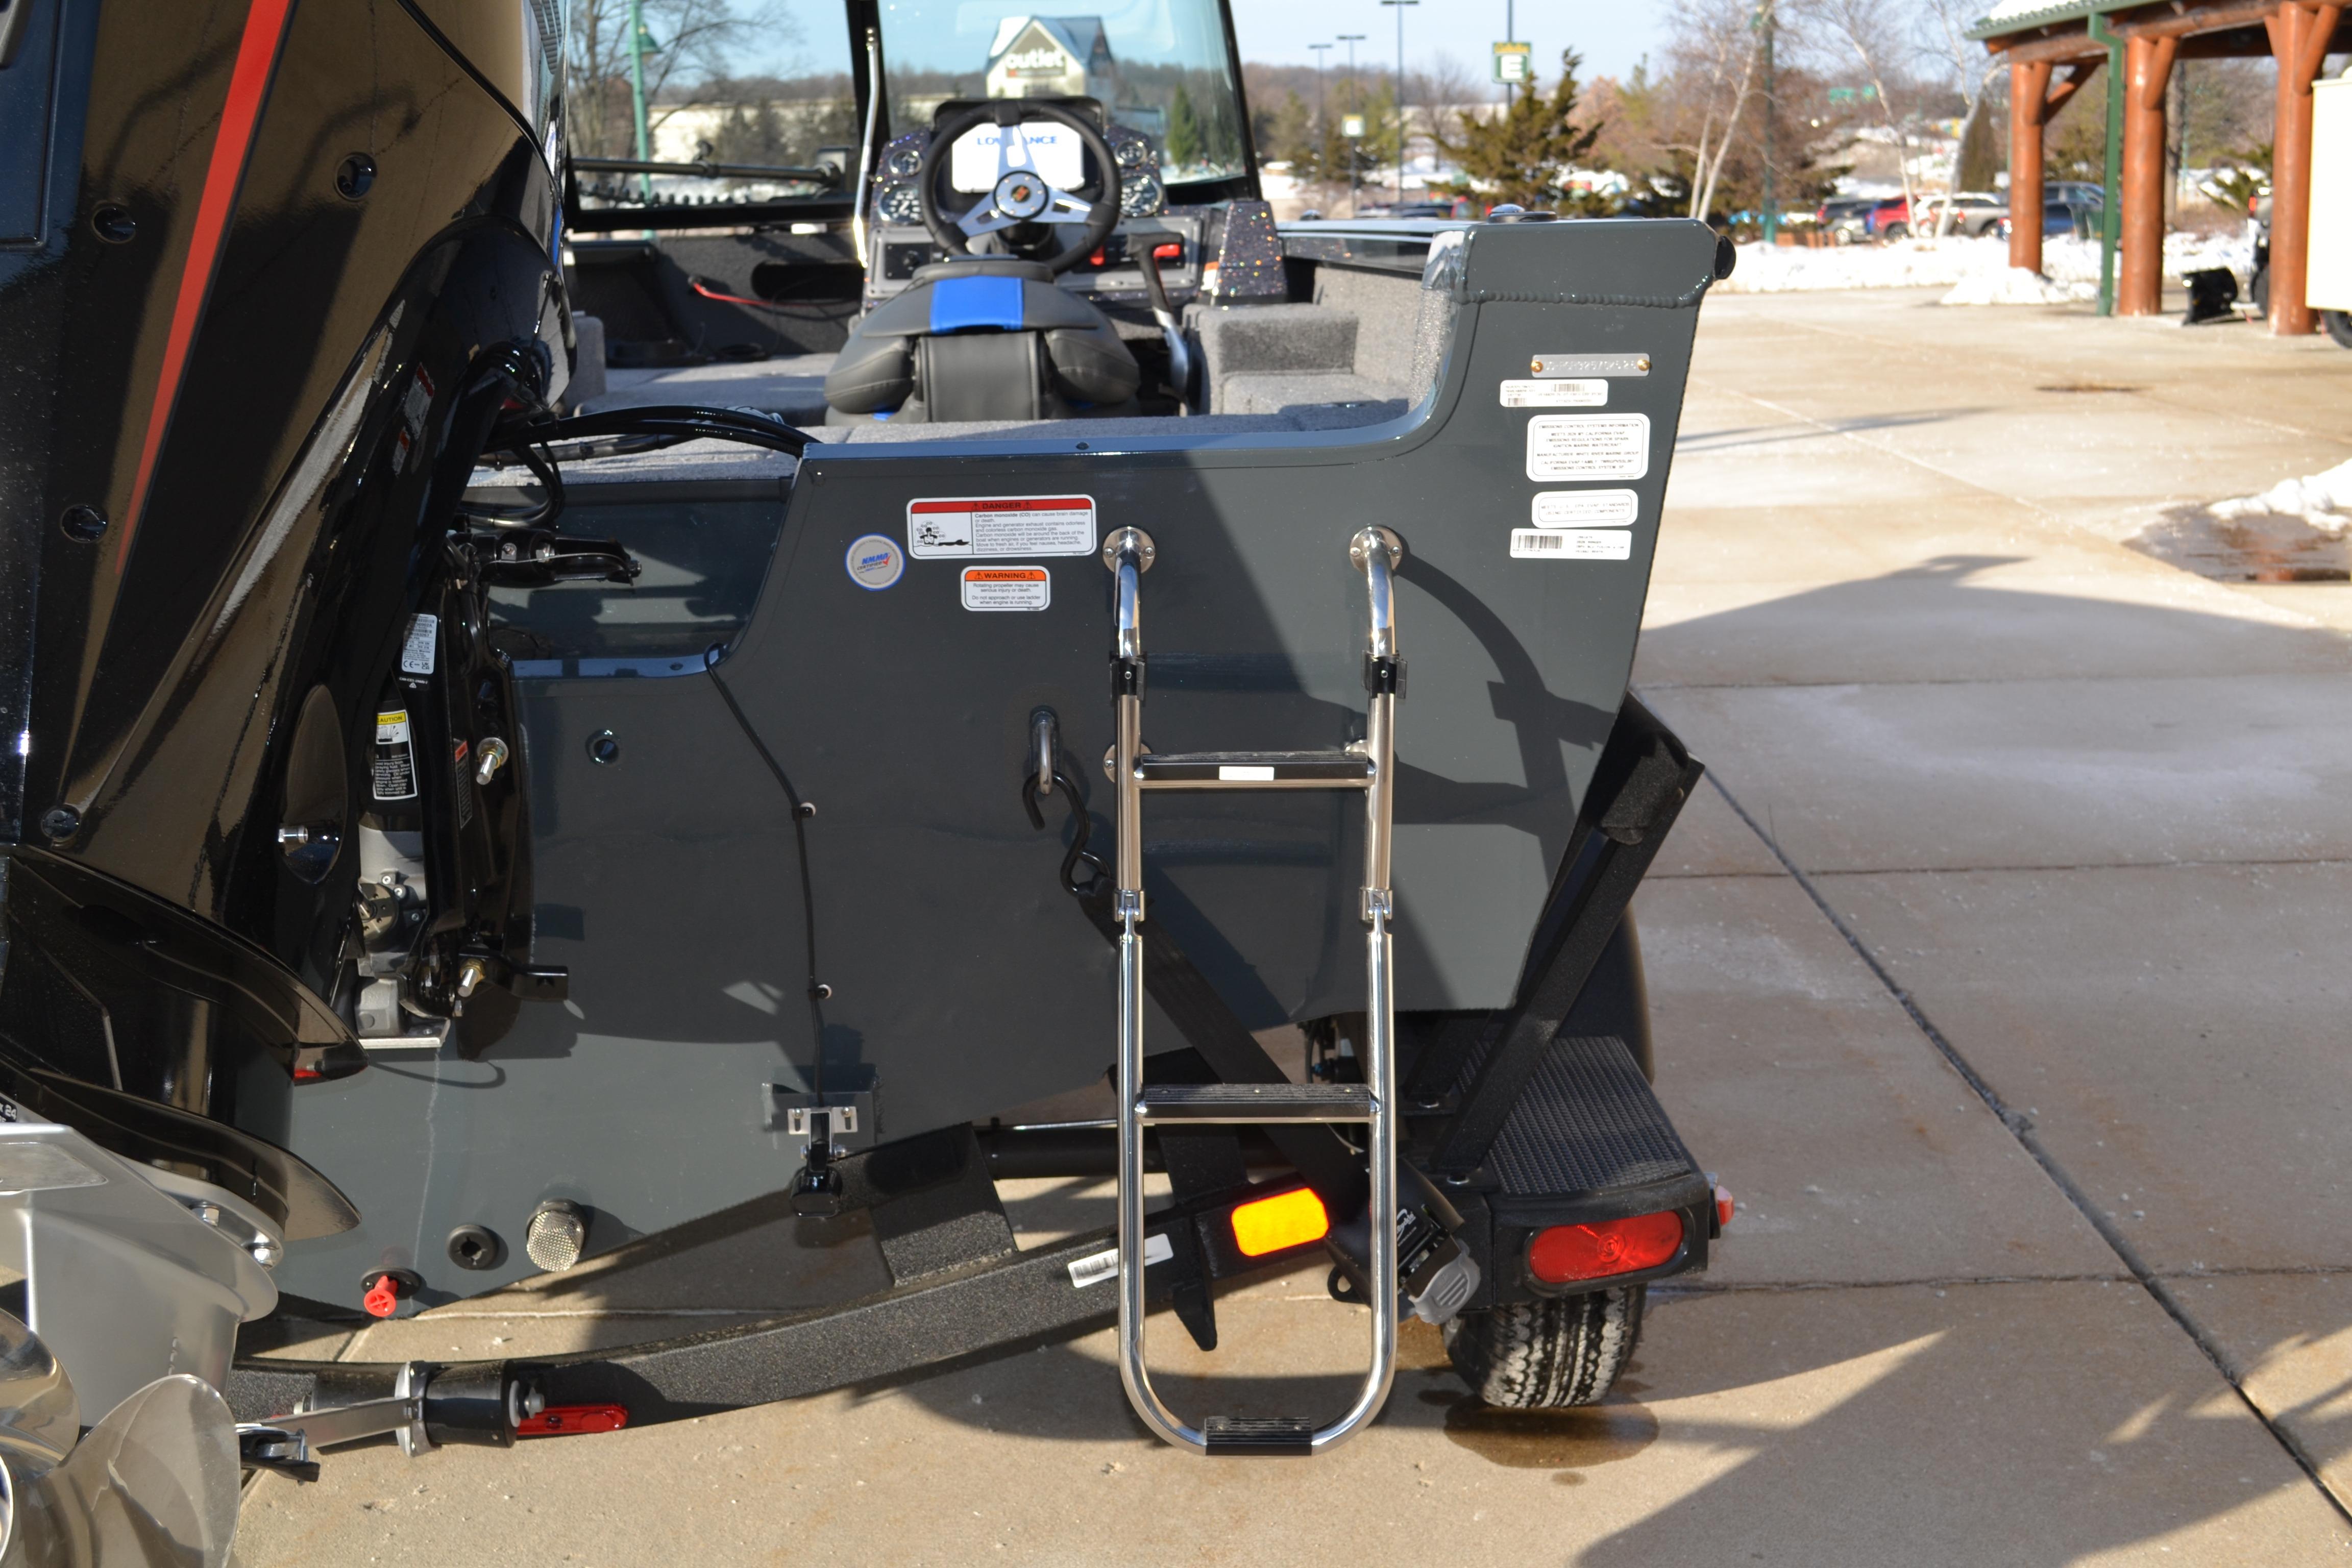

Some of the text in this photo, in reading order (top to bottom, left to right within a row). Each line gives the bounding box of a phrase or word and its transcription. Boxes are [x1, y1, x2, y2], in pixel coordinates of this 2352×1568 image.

[1006, 47, 1065, 68] outlet
[1501, 55, 1522, 79] E
[5, 1104, 17, 1120] 24
